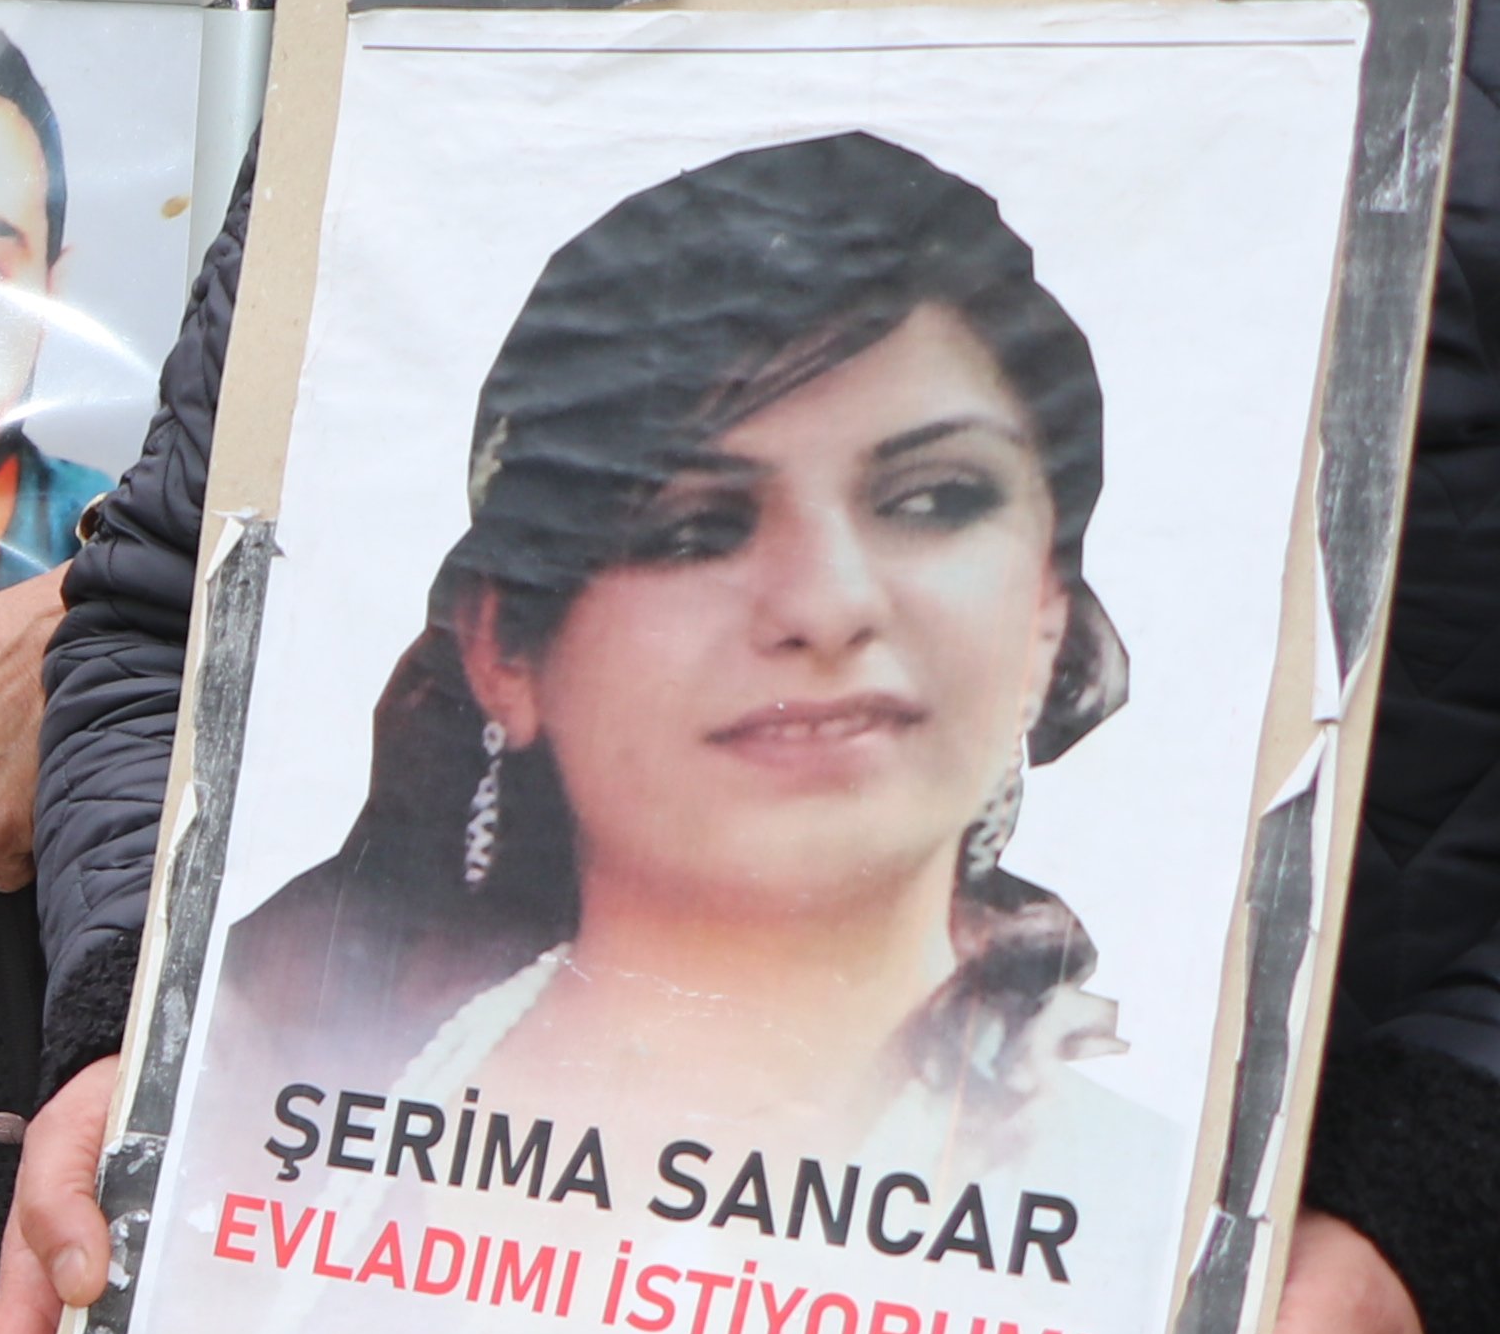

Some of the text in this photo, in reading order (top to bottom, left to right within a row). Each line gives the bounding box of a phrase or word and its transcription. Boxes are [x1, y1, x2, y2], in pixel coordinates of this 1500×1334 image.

[212, 1192, 582, 1320] EVLADIMI
[263, 1083, 1081, 1284] ŞERİMA SANCAR
